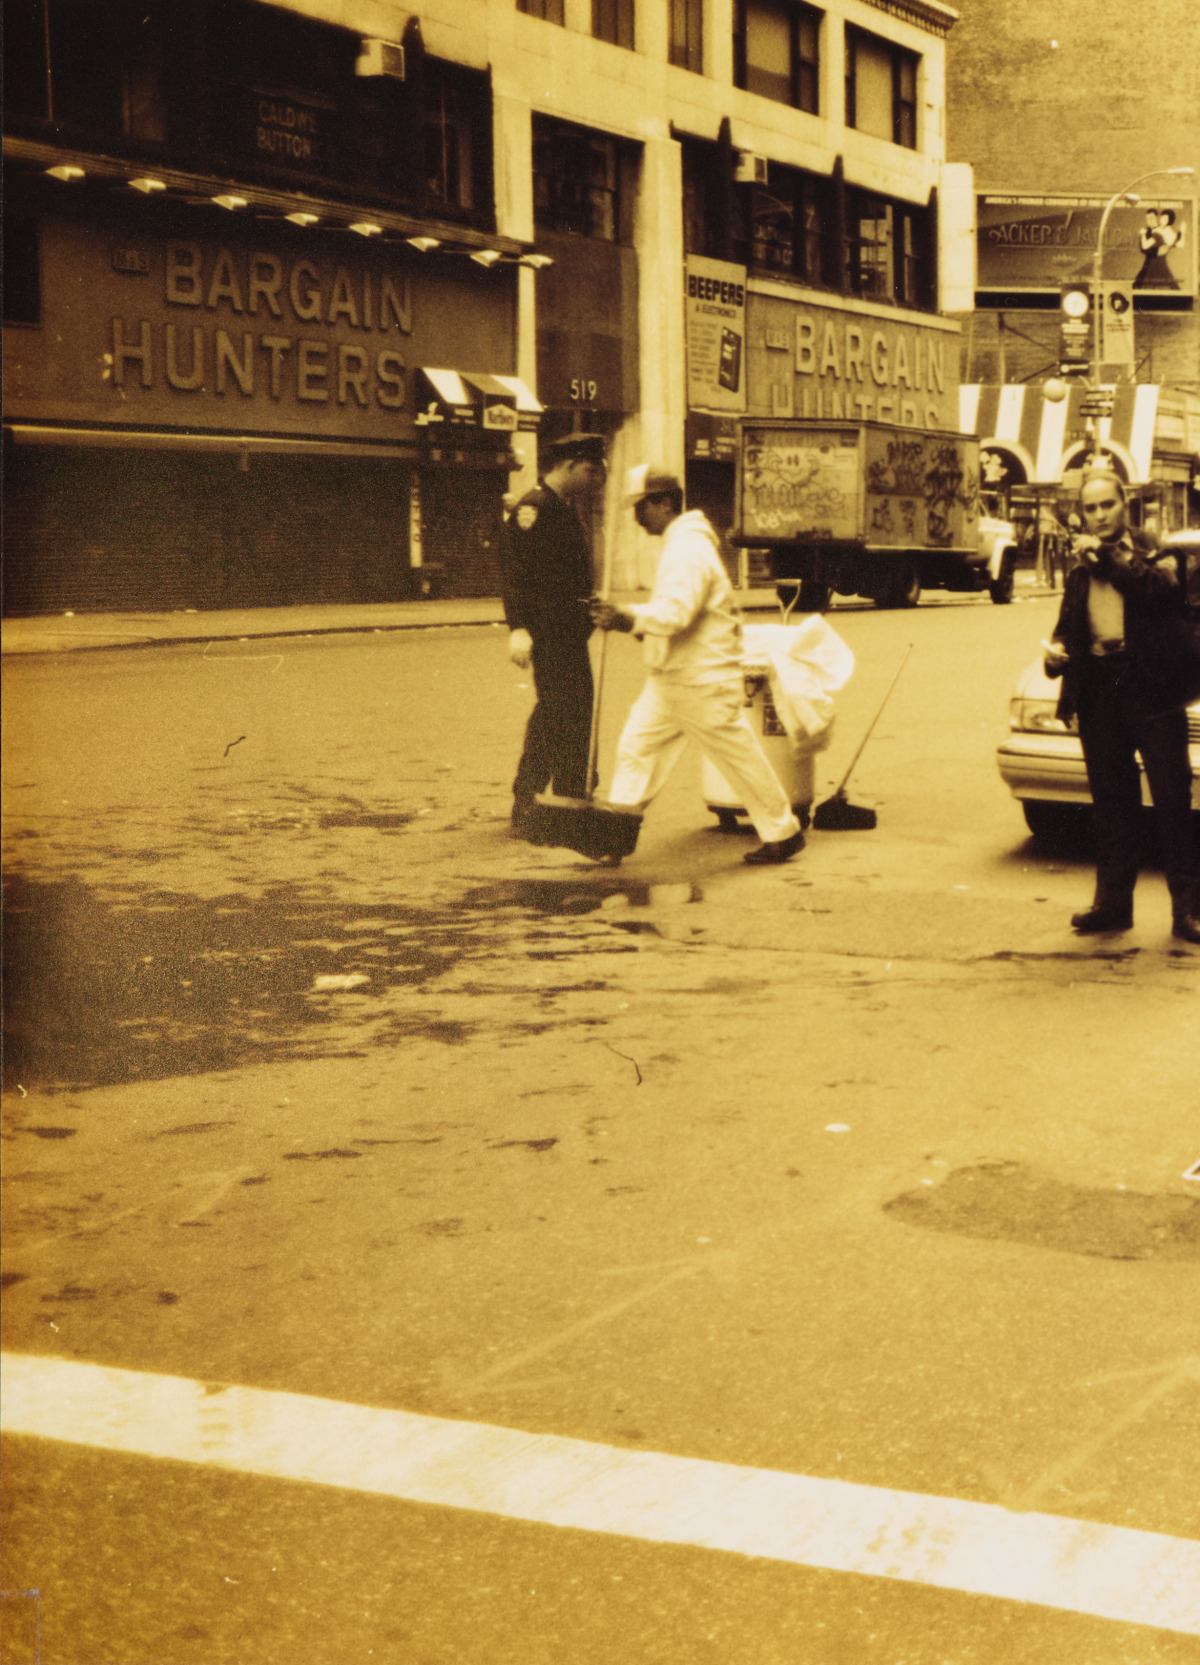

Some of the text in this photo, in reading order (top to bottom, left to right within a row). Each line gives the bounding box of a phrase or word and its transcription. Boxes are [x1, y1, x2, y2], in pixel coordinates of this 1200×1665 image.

[257, 126, 311, 158] BUTTON
[166, 241, 412, 334] BARGAIN
[688, 275, 744, 307] BEEPERS
[110, 318, 407, 408] HUNTERS
[796, 314, 943, 394] BARGAIN
[570, 378, 597, 400] 519
